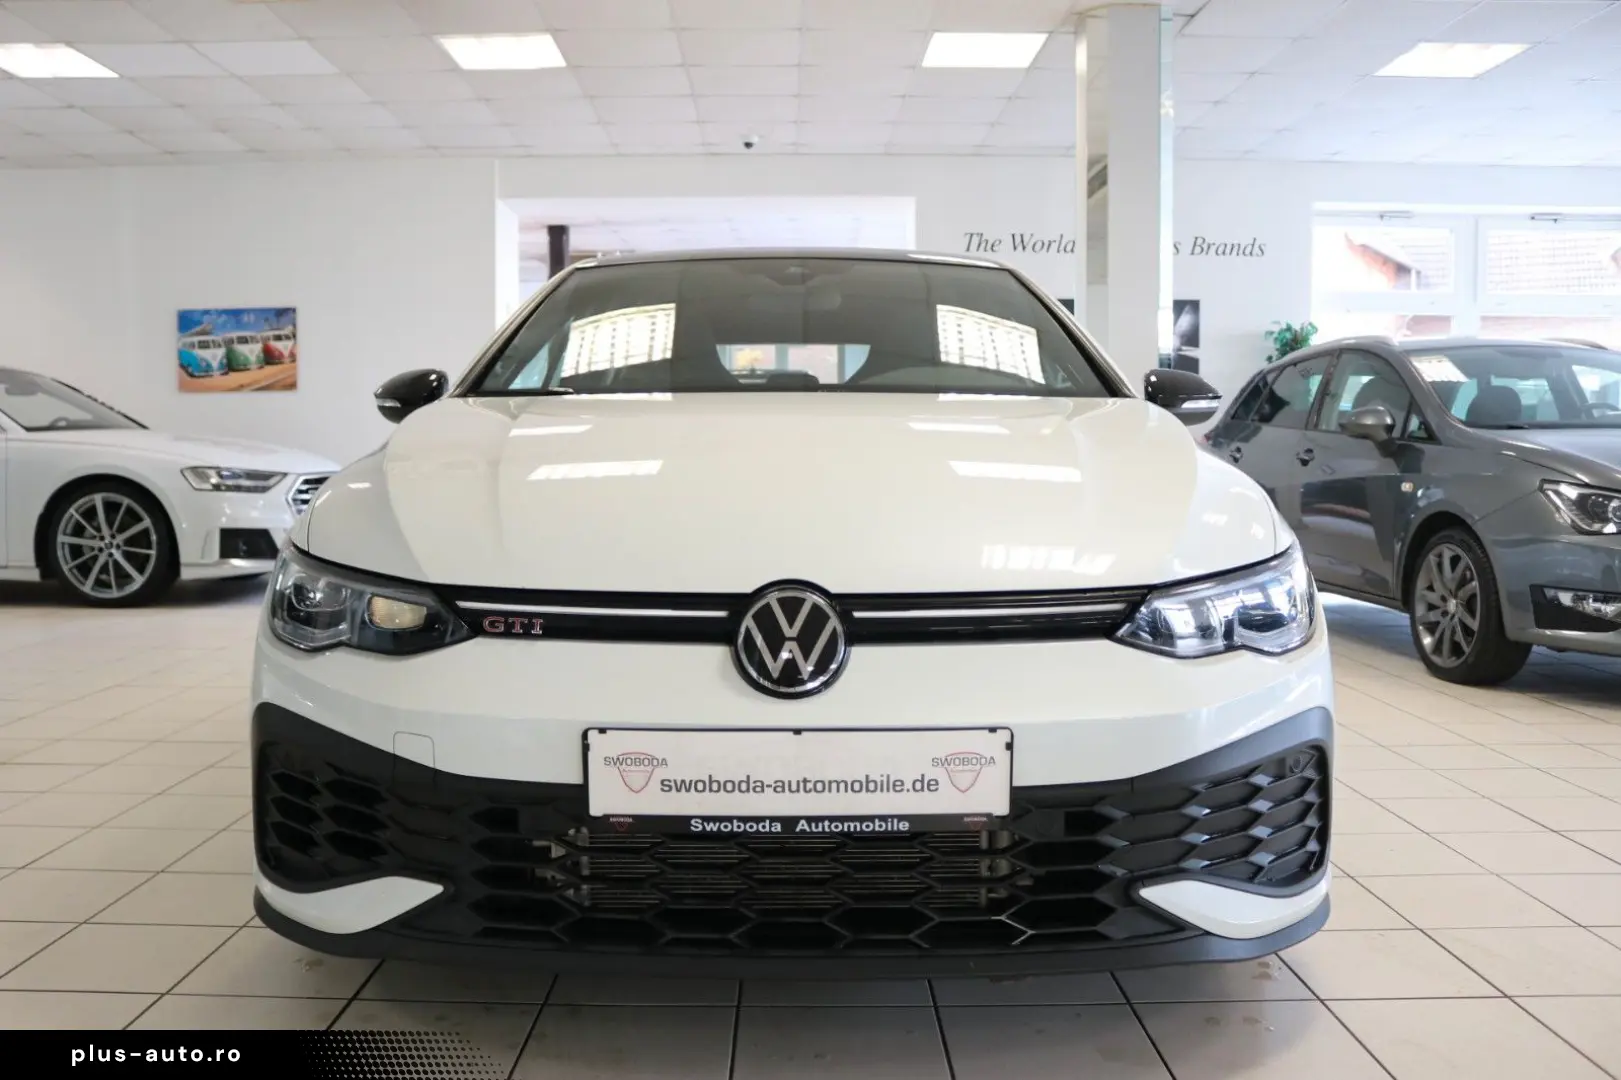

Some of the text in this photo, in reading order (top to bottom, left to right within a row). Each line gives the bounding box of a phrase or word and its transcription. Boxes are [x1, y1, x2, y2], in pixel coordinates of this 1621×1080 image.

[964, 231, 1002, 254] The
[1189, 235, 1267, 258] Brands
[482, 615, 544, 635] GTI
[603, 755, 669, 769] SWOBODA
[931, 755, 997, 769] SWOBODA
[659, 773, 940, 795] swoboda-automobile.de
[689, 817, 911, 833] Swoboda Automobile
